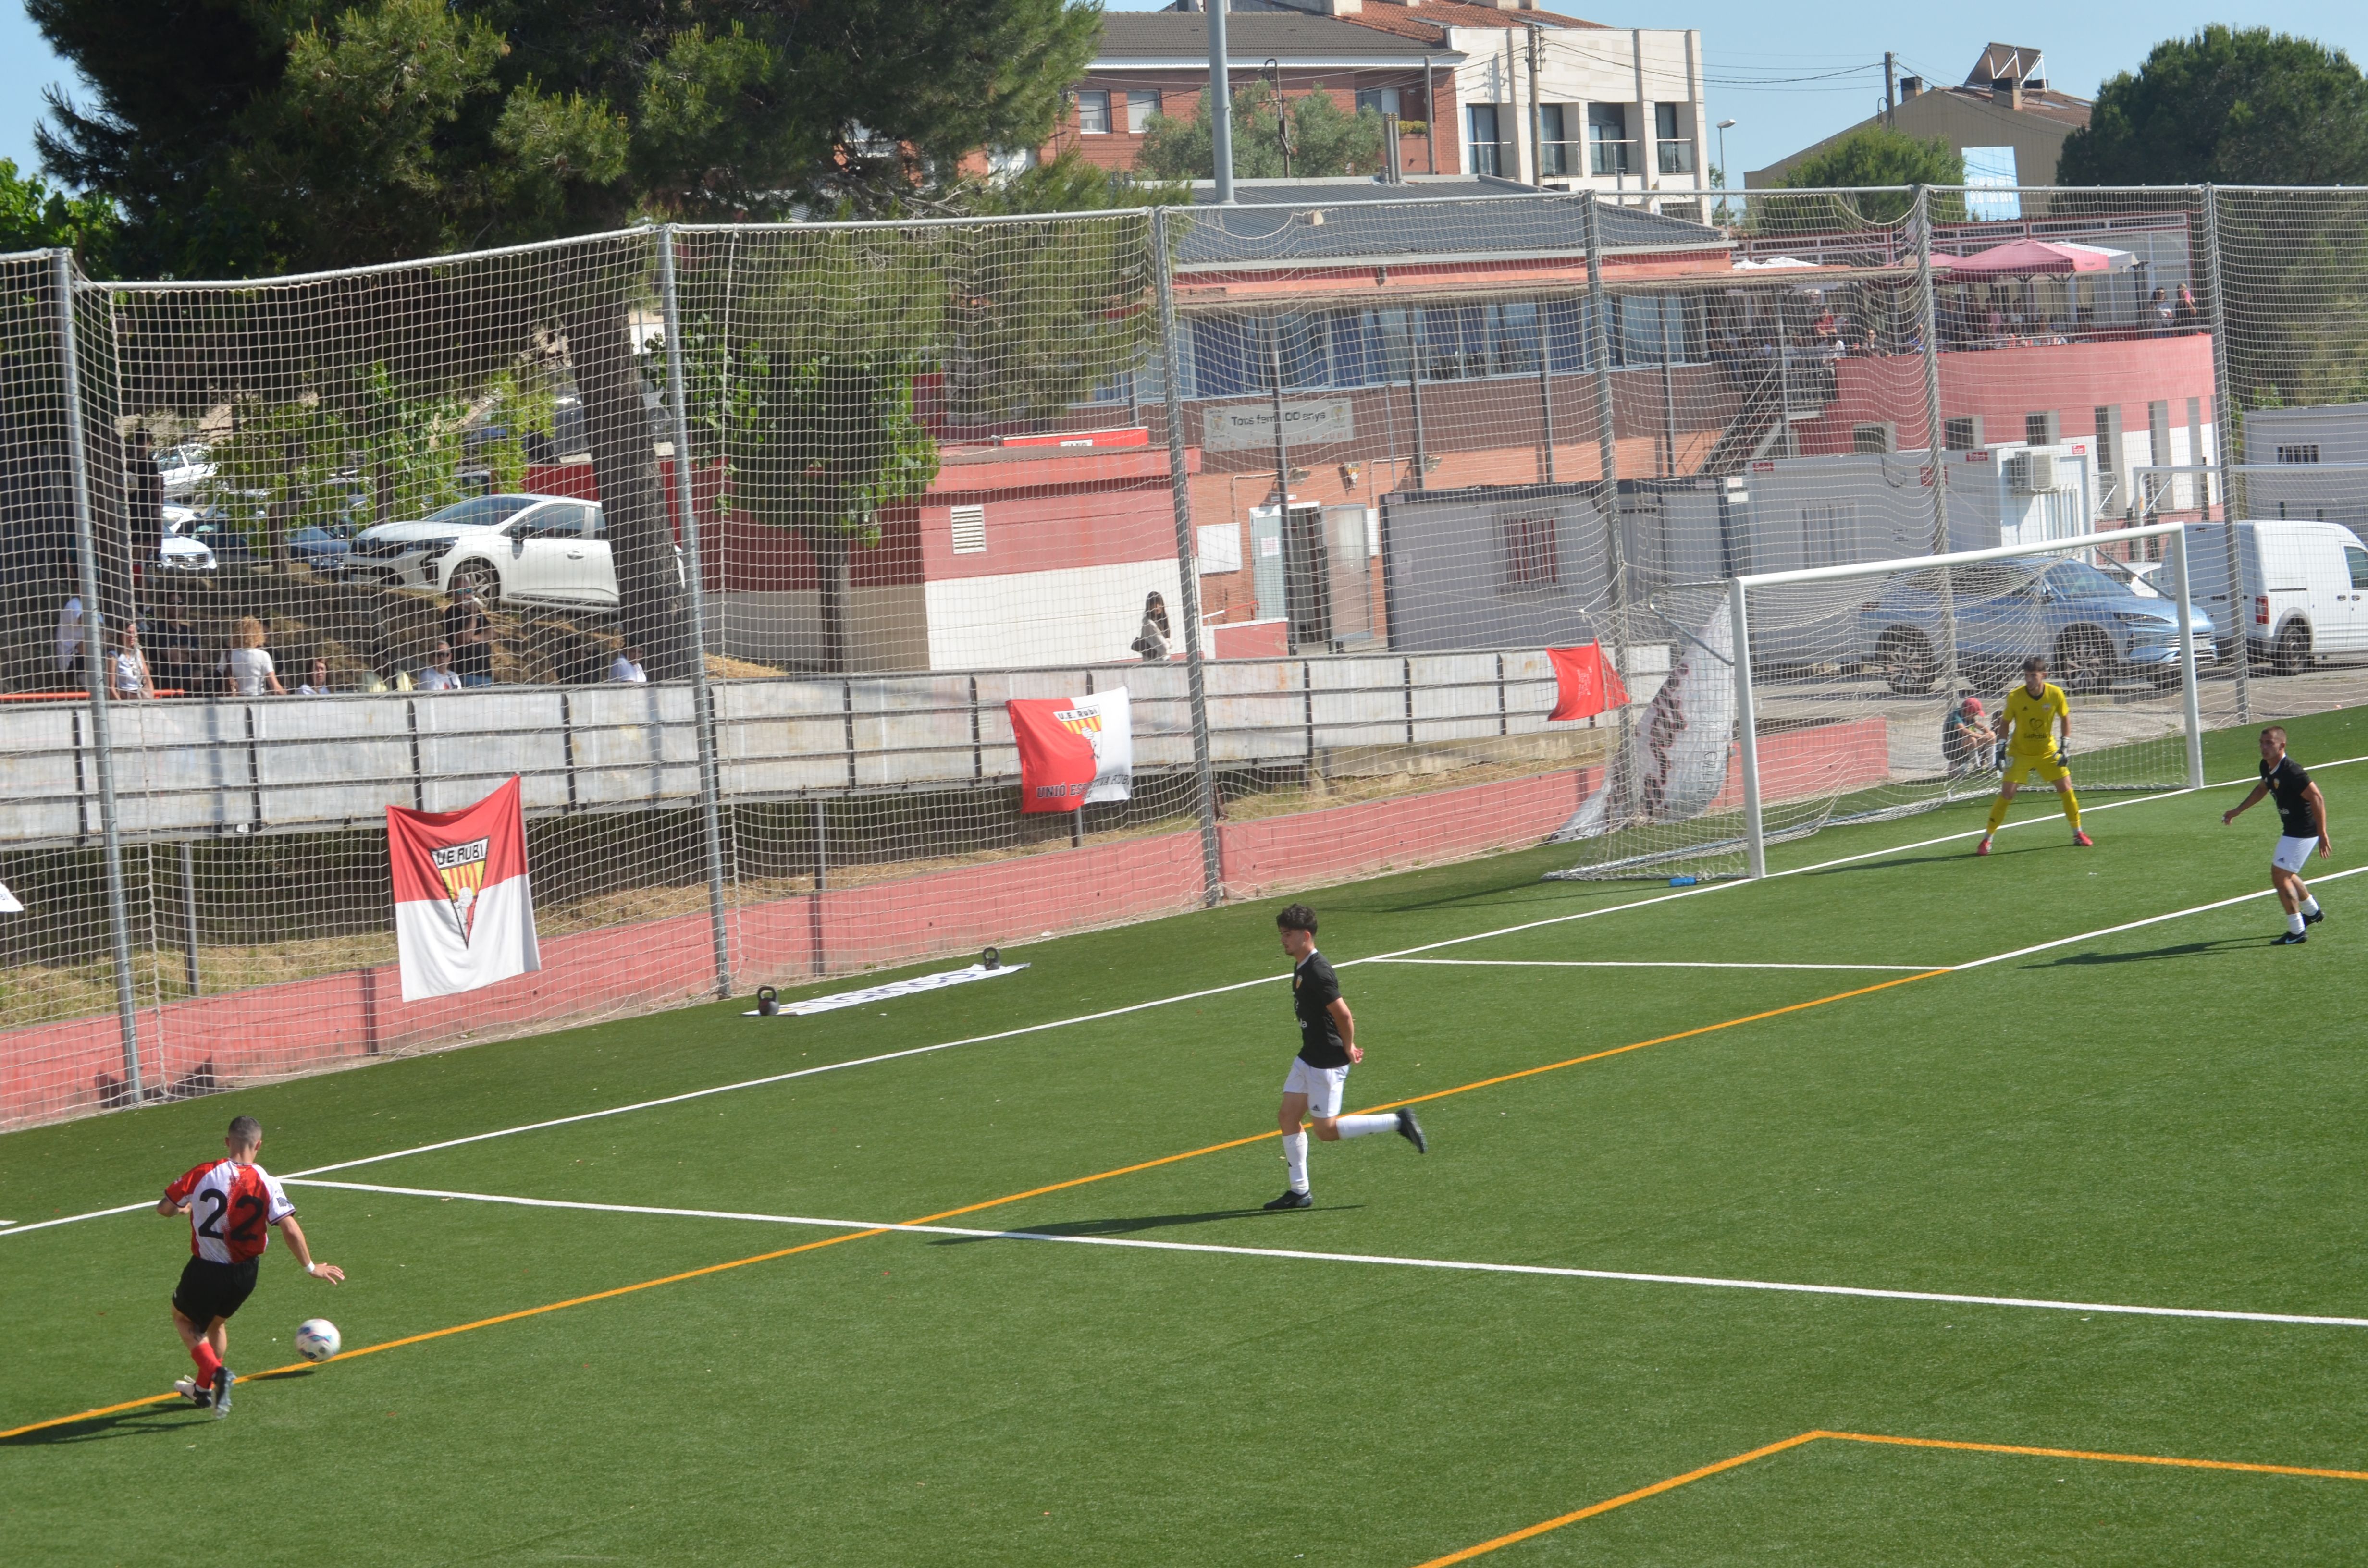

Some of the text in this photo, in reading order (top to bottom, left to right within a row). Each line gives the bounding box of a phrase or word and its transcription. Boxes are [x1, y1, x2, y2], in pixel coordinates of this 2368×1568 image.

[1231, 416, 1254, 426] Tots
[1302, 412, 1326, 422] anys
[1036, 782, 1067, 798] UNIÓ
[437, 844, 483, 865] UE RUBI
[198, 1188, 264, 1241] 22
